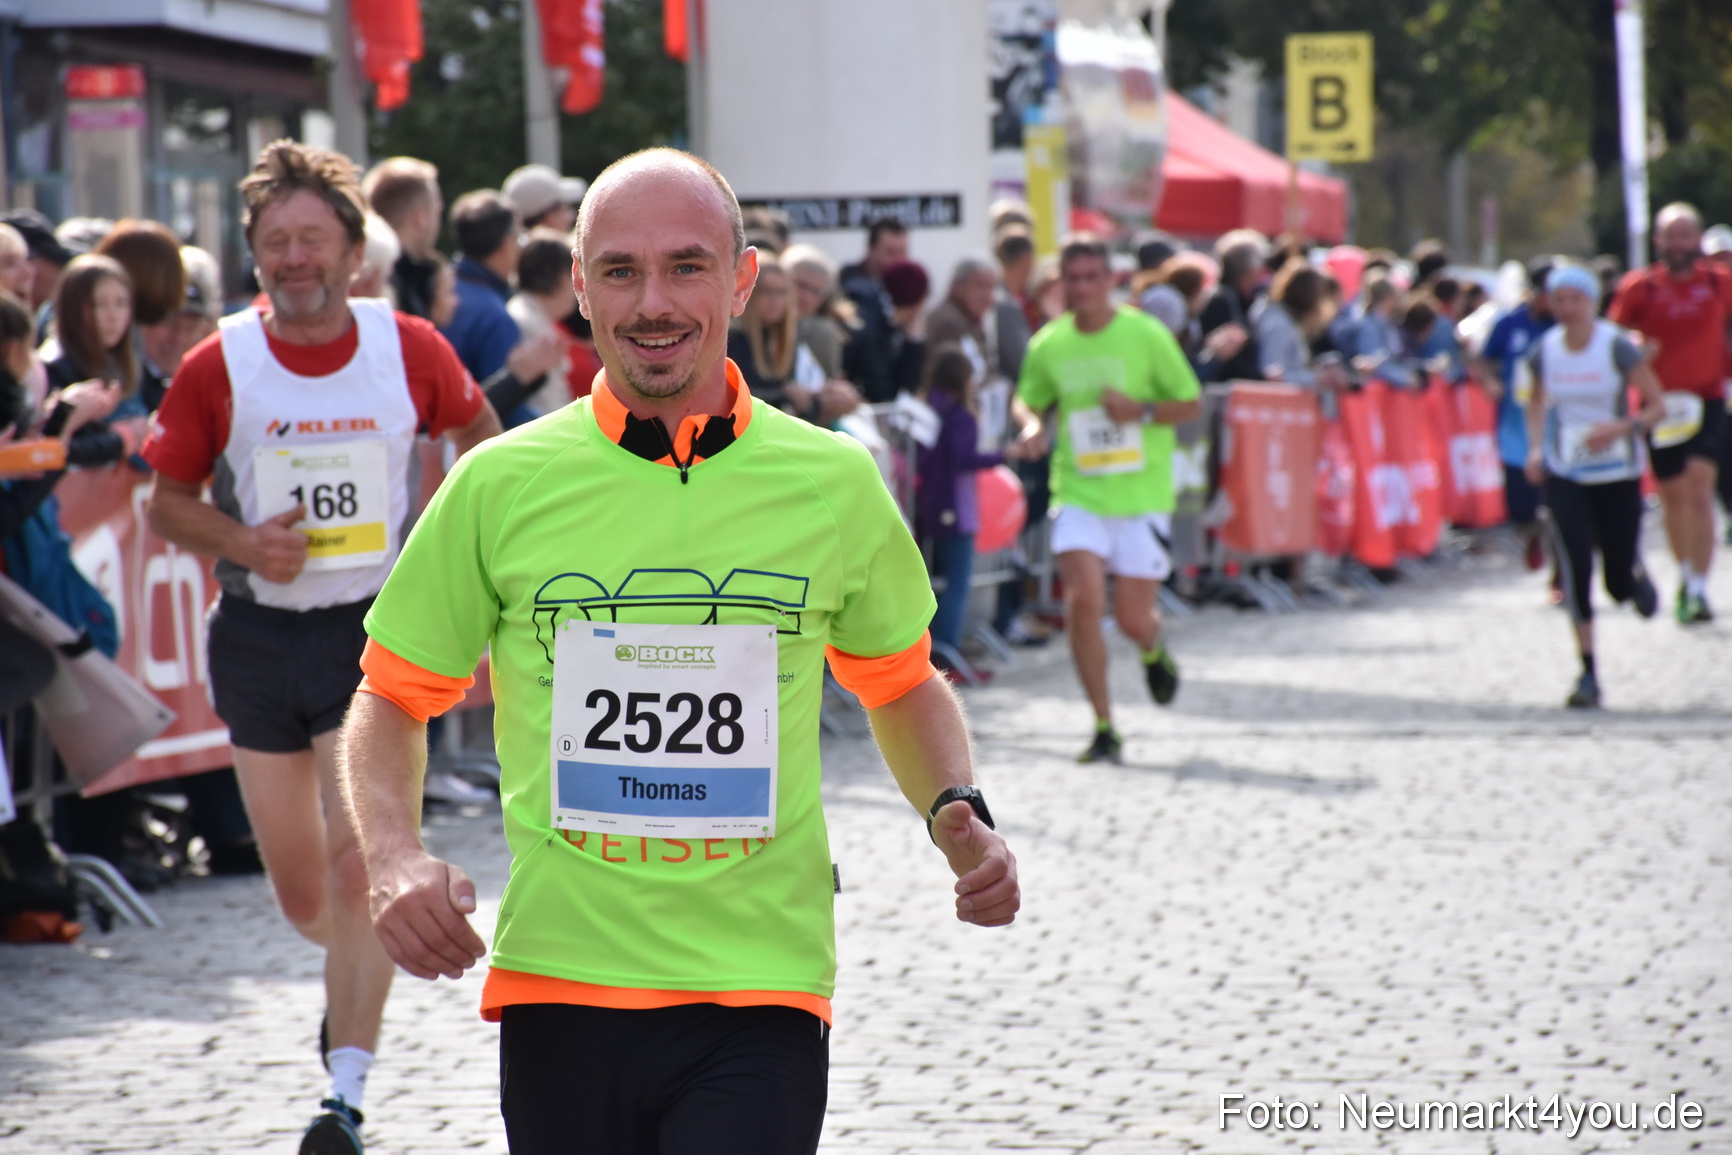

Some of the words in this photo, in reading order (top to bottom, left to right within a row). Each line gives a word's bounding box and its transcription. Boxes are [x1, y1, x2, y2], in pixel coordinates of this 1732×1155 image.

[1311, 74, 1348, 132] B
[297, 418, 381, 433] KLEBL
[637, 645, 715, 663] BOCK
[584, 688, 745, 755] 2528
[563, 740, 571, 751] D
[618, 776, 707, 801] Thomas
